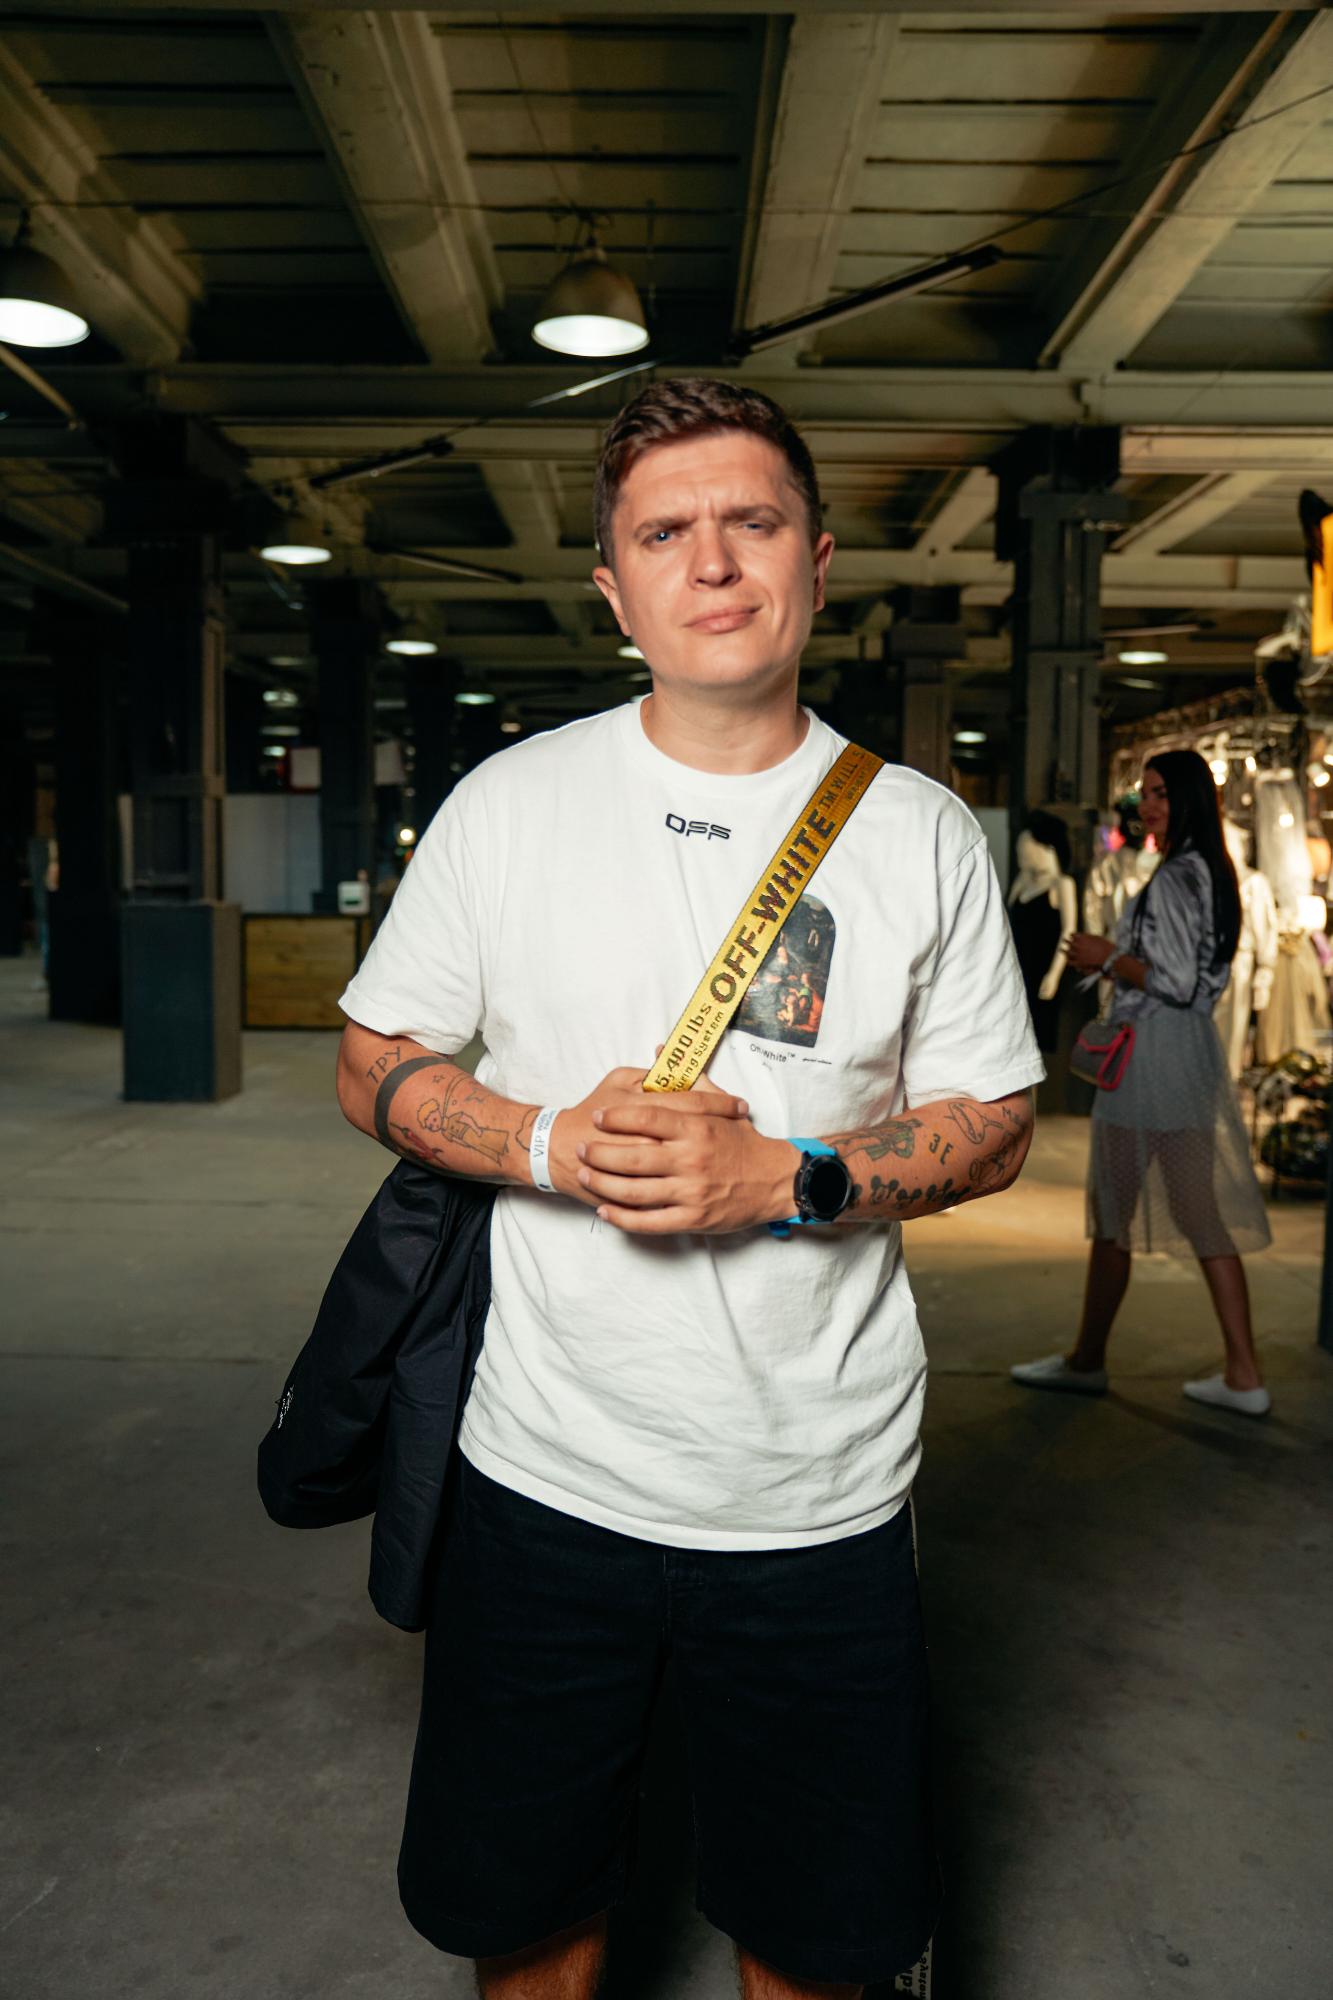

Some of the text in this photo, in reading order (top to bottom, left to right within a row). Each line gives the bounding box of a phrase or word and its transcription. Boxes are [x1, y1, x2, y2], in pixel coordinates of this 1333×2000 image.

[710, 809, 836, 1003] OFF-WHITE
[655, 1003, 712, 1088] 5,400 lbs
[694, 1011, 724, 1056] System
[533, 1135, 544, 1157] VIP
